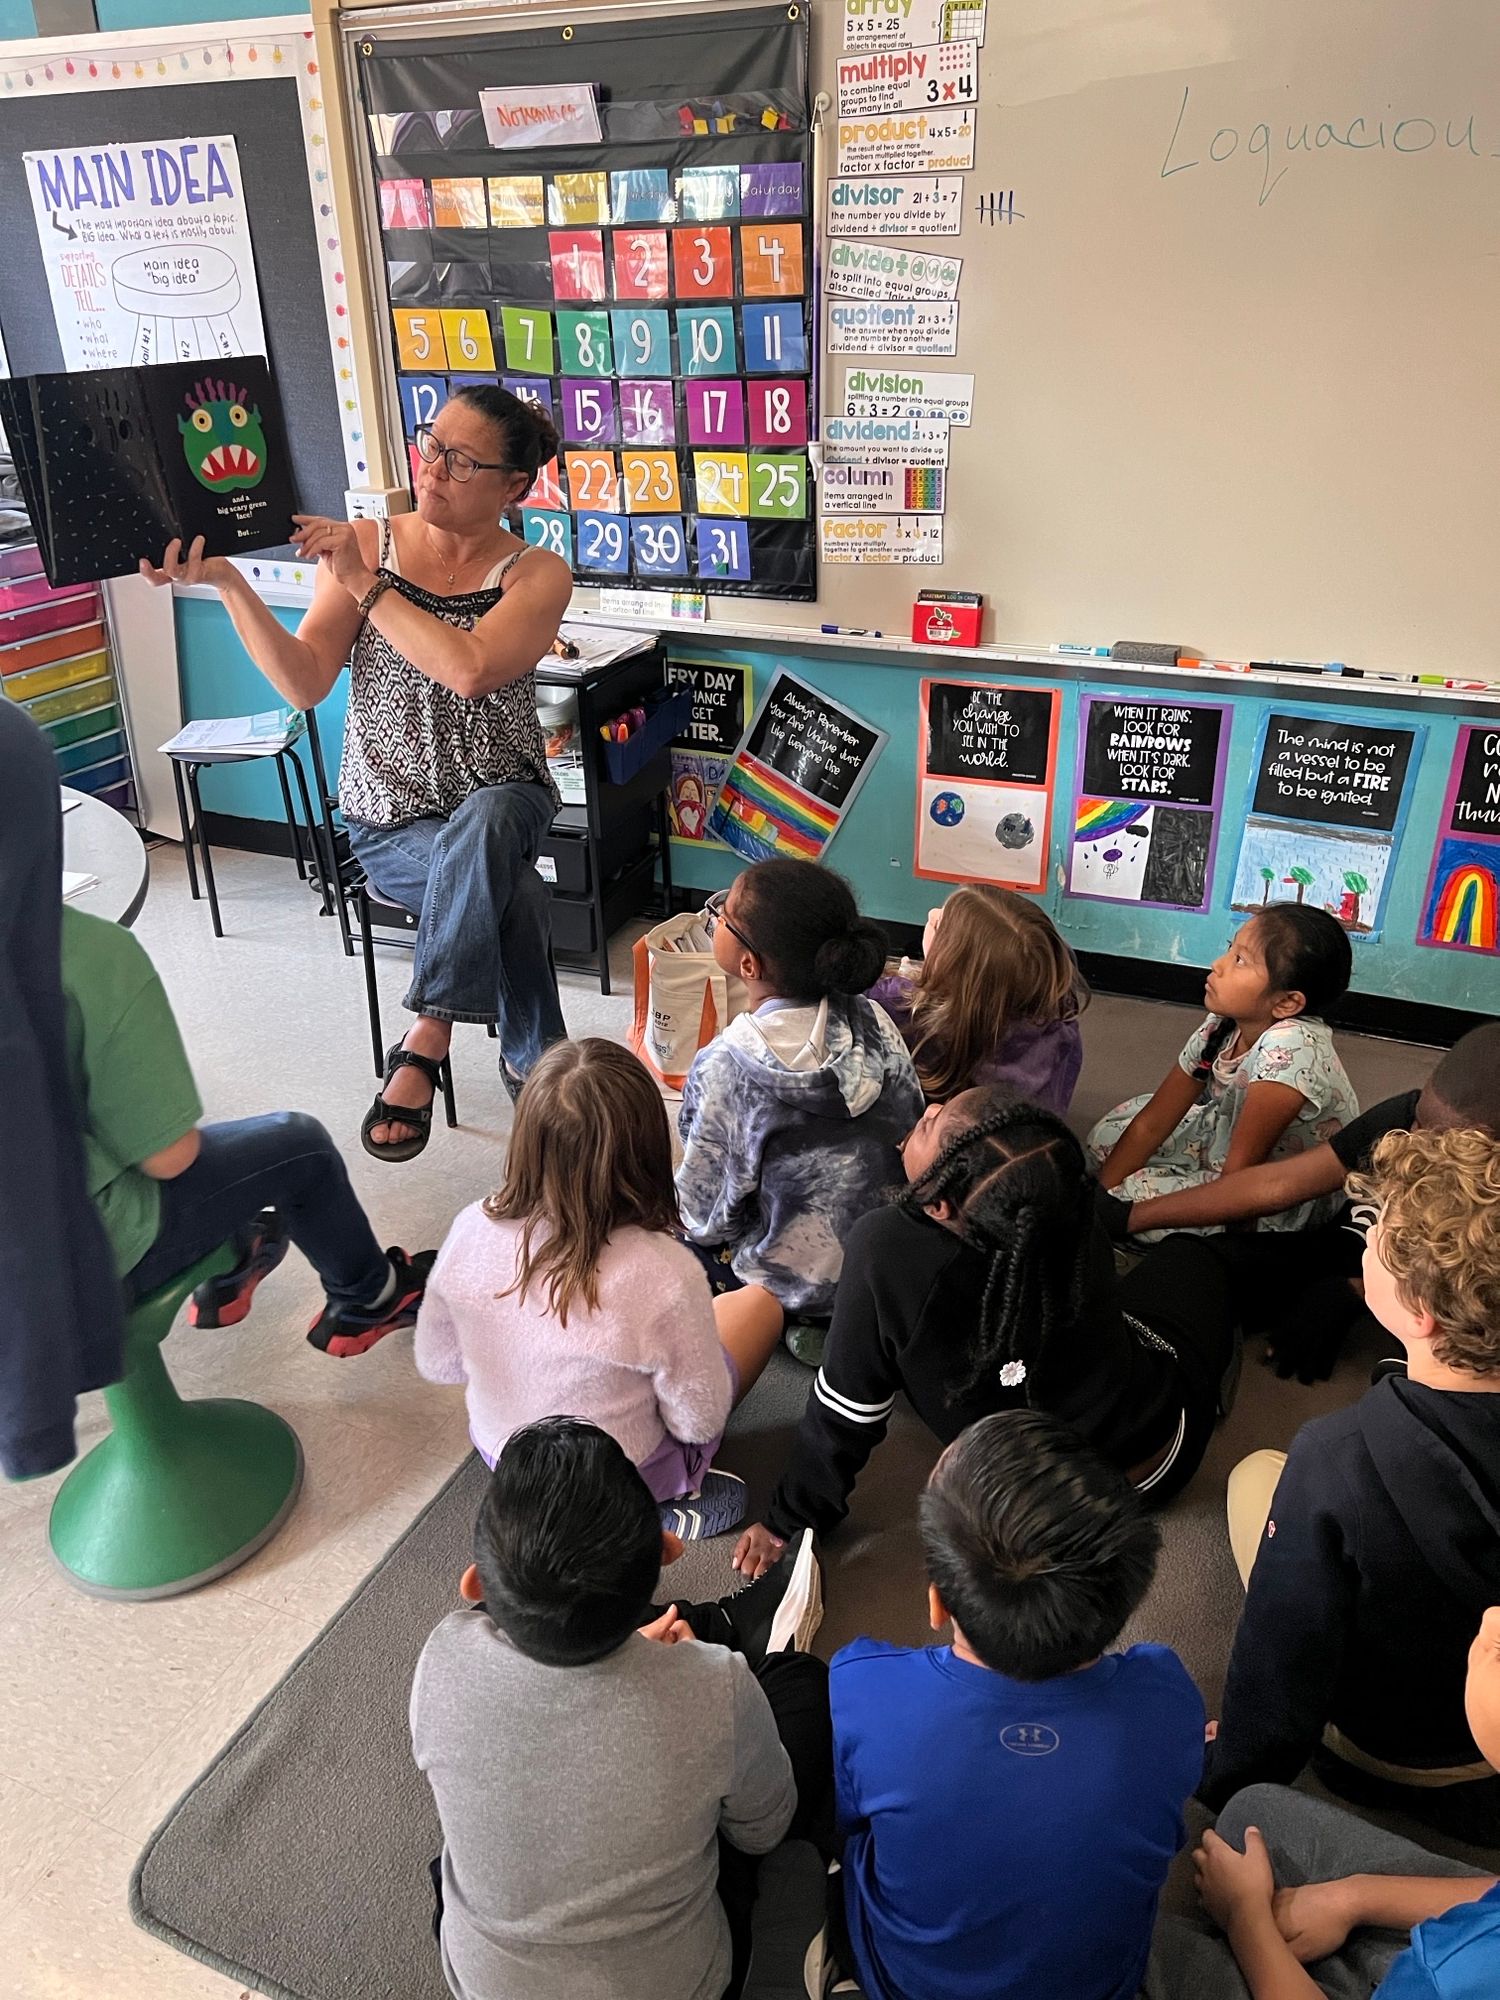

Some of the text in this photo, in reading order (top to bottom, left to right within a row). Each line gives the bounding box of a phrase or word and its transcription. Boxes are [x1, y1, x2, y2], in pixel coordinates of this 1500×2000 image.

[840, 51, 926, 83] multiply
[841, 80, 910, 96] to combine equal
[927, 80, 939, 102] 3
[959, 75, 972, 97] 4
[840, 116, 927, 148] product
[1161, 86, 1500, 206] Loquaciou
[841, 161, 870, 173] factor
[884, 159, 915, 170] factor
[928, 155, 971, 171] product
[875, 151, 905, 160] multiplied
[37, 143, 234, 212] MAIN IDEA
[831, 184, 903, 205] divisor
[848, 211, 882, 220] number
[884, 212, 901, 222] you
[904, 211, 931, 219] divide
[935, 211, 945, 221] by
[831, 223, 956, 233] dividend divisor quotient
[173, 257, 199, 270] idea
[571, 237, 784, 289] 1 2 3 4
[831, 244, 893, 273] divide
[60, 263, 107, 288] DETAILS
[830, 269, 839, 279] to
[842, 272, 861, 284] split
[864, 276, 881, 286] into
[885, 281, 912, 292] equal
[915, 285, 950, 299] groups,
[82, 319, 102, 328] who
[831, 304, 915, 329] quotient
[409, 315, 781, 367] 5 6 7 8 9 10 11
[910, 328, 924, 337] you
[926, 327, 950, 335] divide
[89, 348, 118, 359] where
[915, 344, 951, 354] quotient
[848, 372, 923, 394] division
[412, 384, 790, 434] 12 15 16 17 18
[826, 420, 910, 440] dividend
[910, 446, 932, 454] divide
[571, 458, 799, 506] 22 23 24 25
[825, 467, 893, 485] column
[825, 492, 845, 500] items
[847, 493, 883, 502] arranged
[217, 501, 267, 515] big scary green
[823, 520, 887, 538] factor
[529, 516, 738, 569] 28 29 30 31
[704, 672, 735, 690] DAY
[986, 691, 1002, 705] THE
[692, 707, 714, 720] GET
[784, 691, 859, 747] Always Remember
[963, 703, 1012, 724] change
[1114, 706, 1143, 719] WHEN
[1146, 707, 1158, 719] IT
[789, 715, 805, 732] Are
[806, 727, 837, 754] Unique
[952, 720, 1020, 738] YOU WISH TO
[1124, 720, 1180, 736] LOOK FOR
[770, 722, 840, 776] Like Everyone Else
[961, 735, 1008, 751] SEE IN THE
[1110, 733, 1192, 752] RAINBOWS
[1278, 729, 1396, 758] The mind is not
[959, 751, 1009, 768] world.
[1107, 749, 1136, 762] WHEN
[1139, 750, 1160, 764] IT'S
[1279, 751, 1386, 774] a vessel to be
[1119, 764, 1175, 780] LOOK FOR
[1268, 762, 1391, 791] filled but a FIRE
[1122, 778, 1172, 795] STARS.
[1278, 781, 1373, 806] to be ignited.
